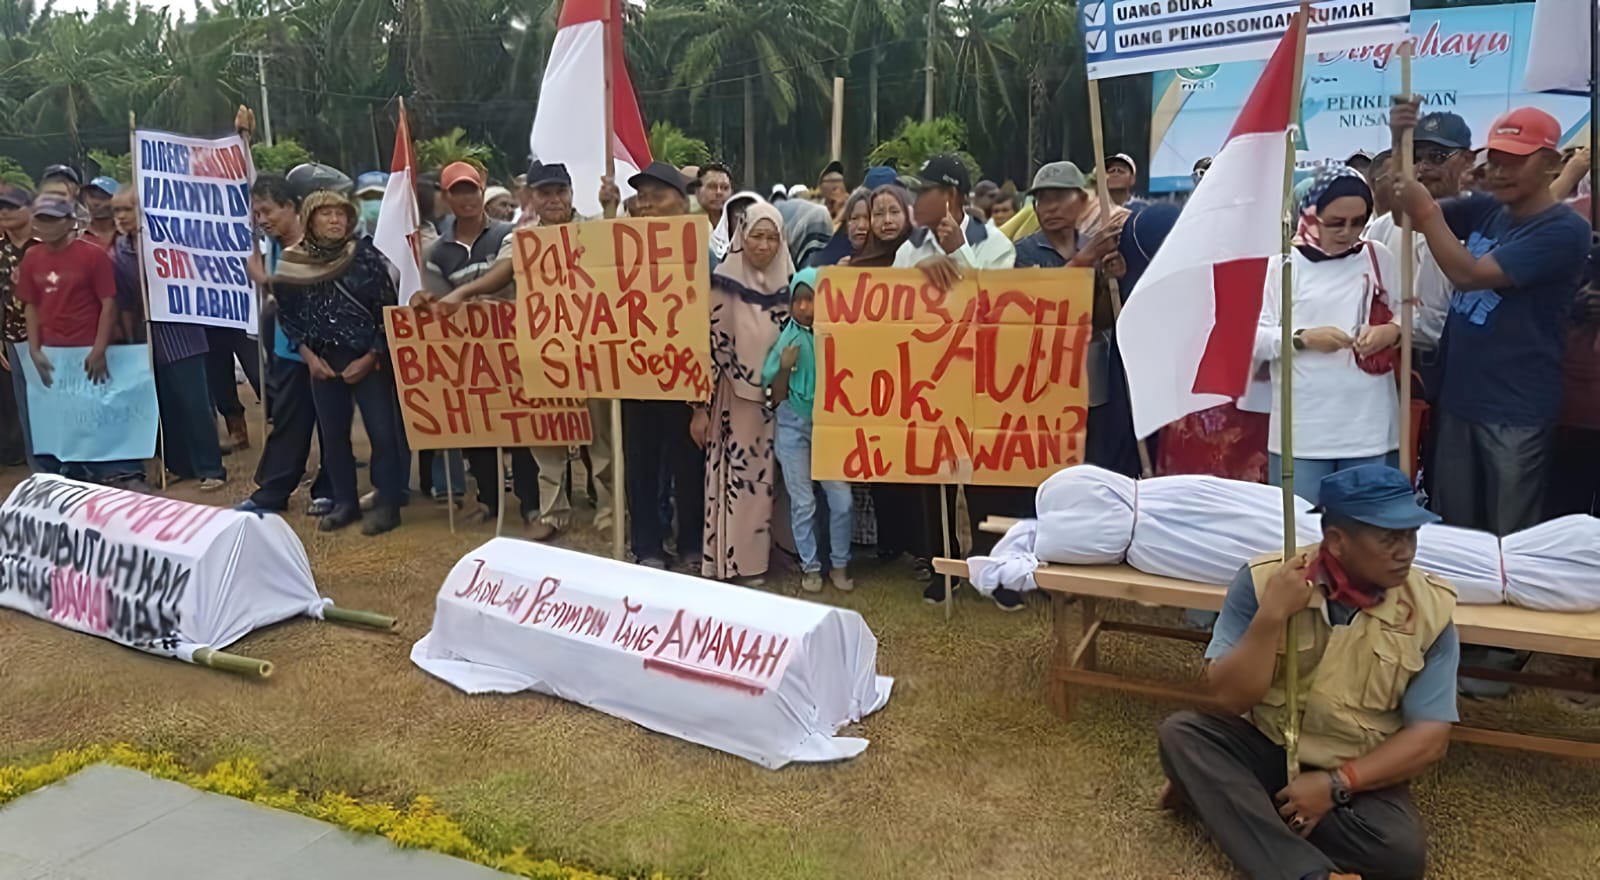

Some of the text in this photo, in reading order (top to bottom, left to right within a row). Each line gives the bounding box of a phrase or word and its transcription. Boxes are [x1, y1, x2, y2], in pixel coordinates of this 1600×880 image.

[1117, 2, 1162, 21] UANG
[1119, 30, 1162, 48] UANG
[144, 177, 225, 216] HAKNYA
[153, 248, 195, 280] SHT
[516, 226, 595, 291] Pak
[167, 284, 192, 315] DI
[397, 342, 522, 387] BAYAR
[540, 338, 627, 392] SHT
[931, 290, 1091, 403] ACEH
[404, 387, 501, 435] SHT
[843, 428, 892, 480] di
[653, 609, 789, 678] AMANAH
